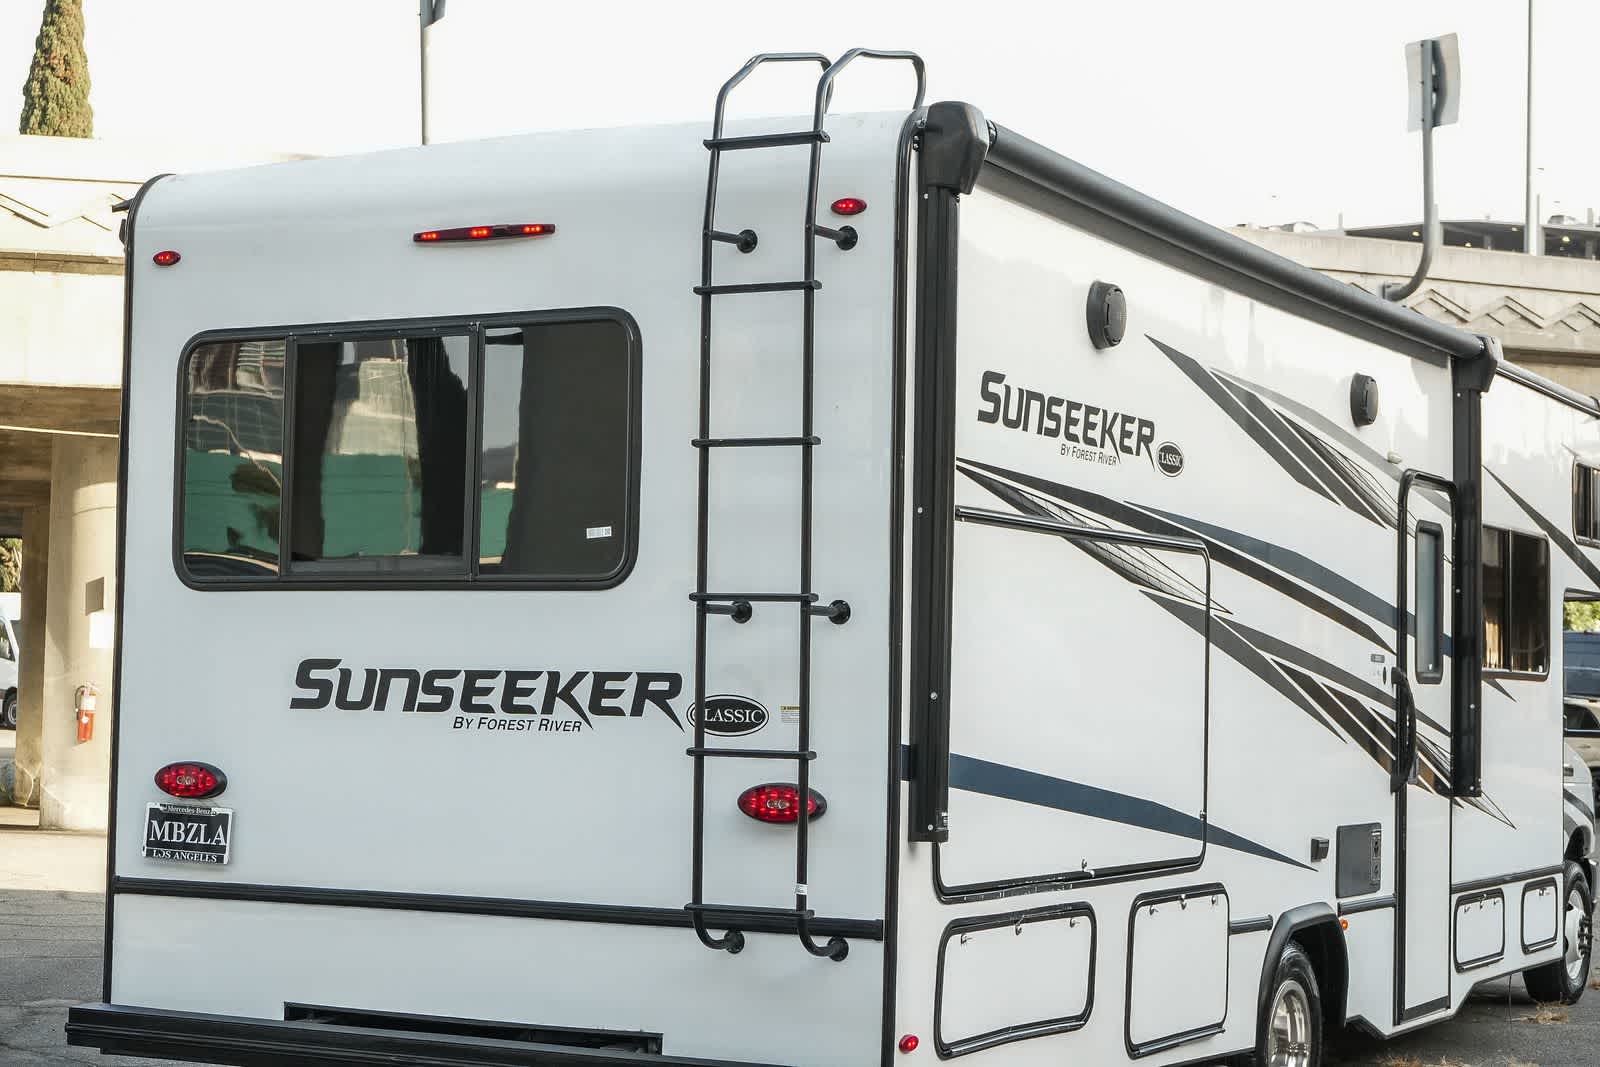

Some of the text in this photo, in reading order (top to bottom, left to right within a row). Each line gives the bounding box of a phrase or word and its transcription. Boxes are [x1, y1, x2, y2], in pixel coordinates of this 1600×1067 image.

[977, 370, 1155, 472] SUNSEEKER
[290, 658, 685, 733] SUNSEEKER
[477, 717, 535, 731] FOREST
[538, 718, 583, 732] RIVER
[692, 708, 764, 723] LASSIC
[148, 819, 228, 846] MBZLA
[153, 849, 171, 859] LOS
